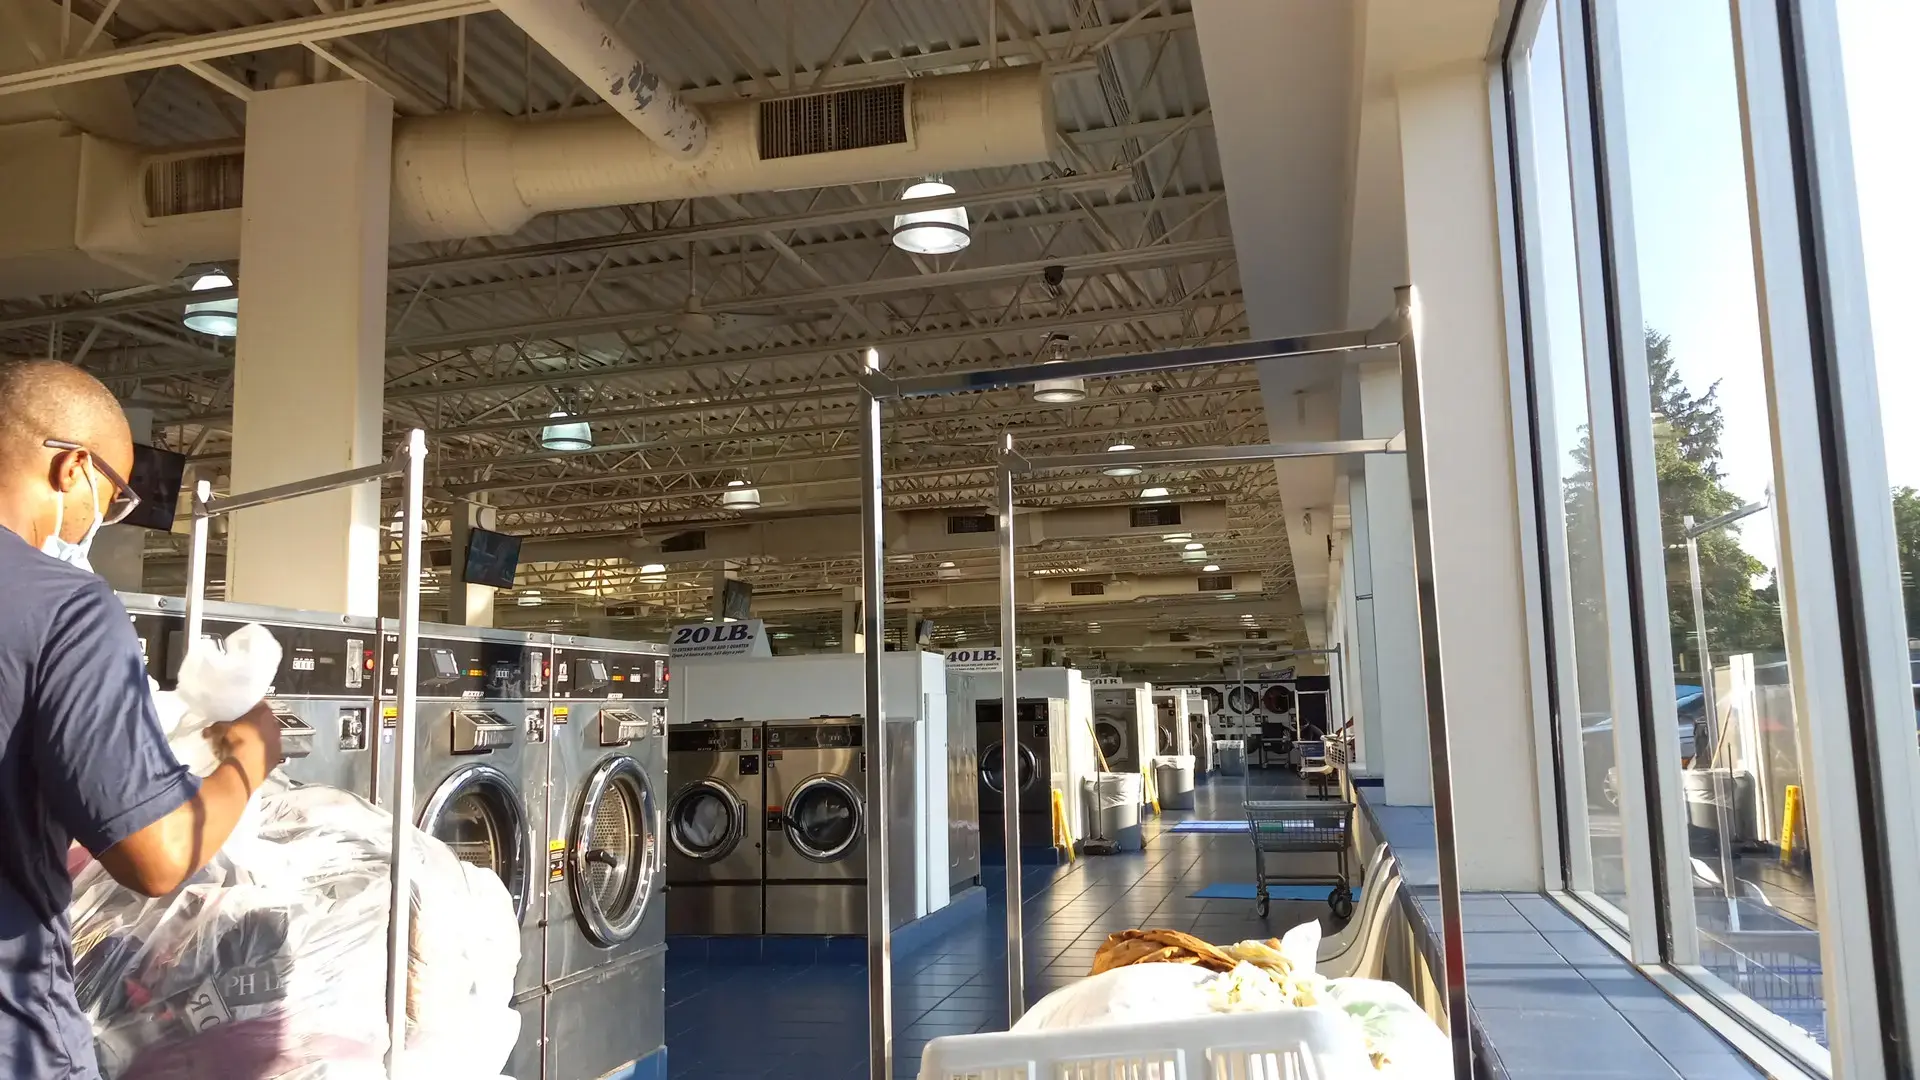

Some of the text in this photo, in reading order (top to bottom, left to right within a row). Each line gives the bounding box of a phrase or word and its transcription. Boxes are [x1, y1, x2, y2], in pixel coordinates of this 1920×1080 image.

[674, 625, 753, 644] 20 LB.
[946, 650, 1001, 662] 40 LB.
